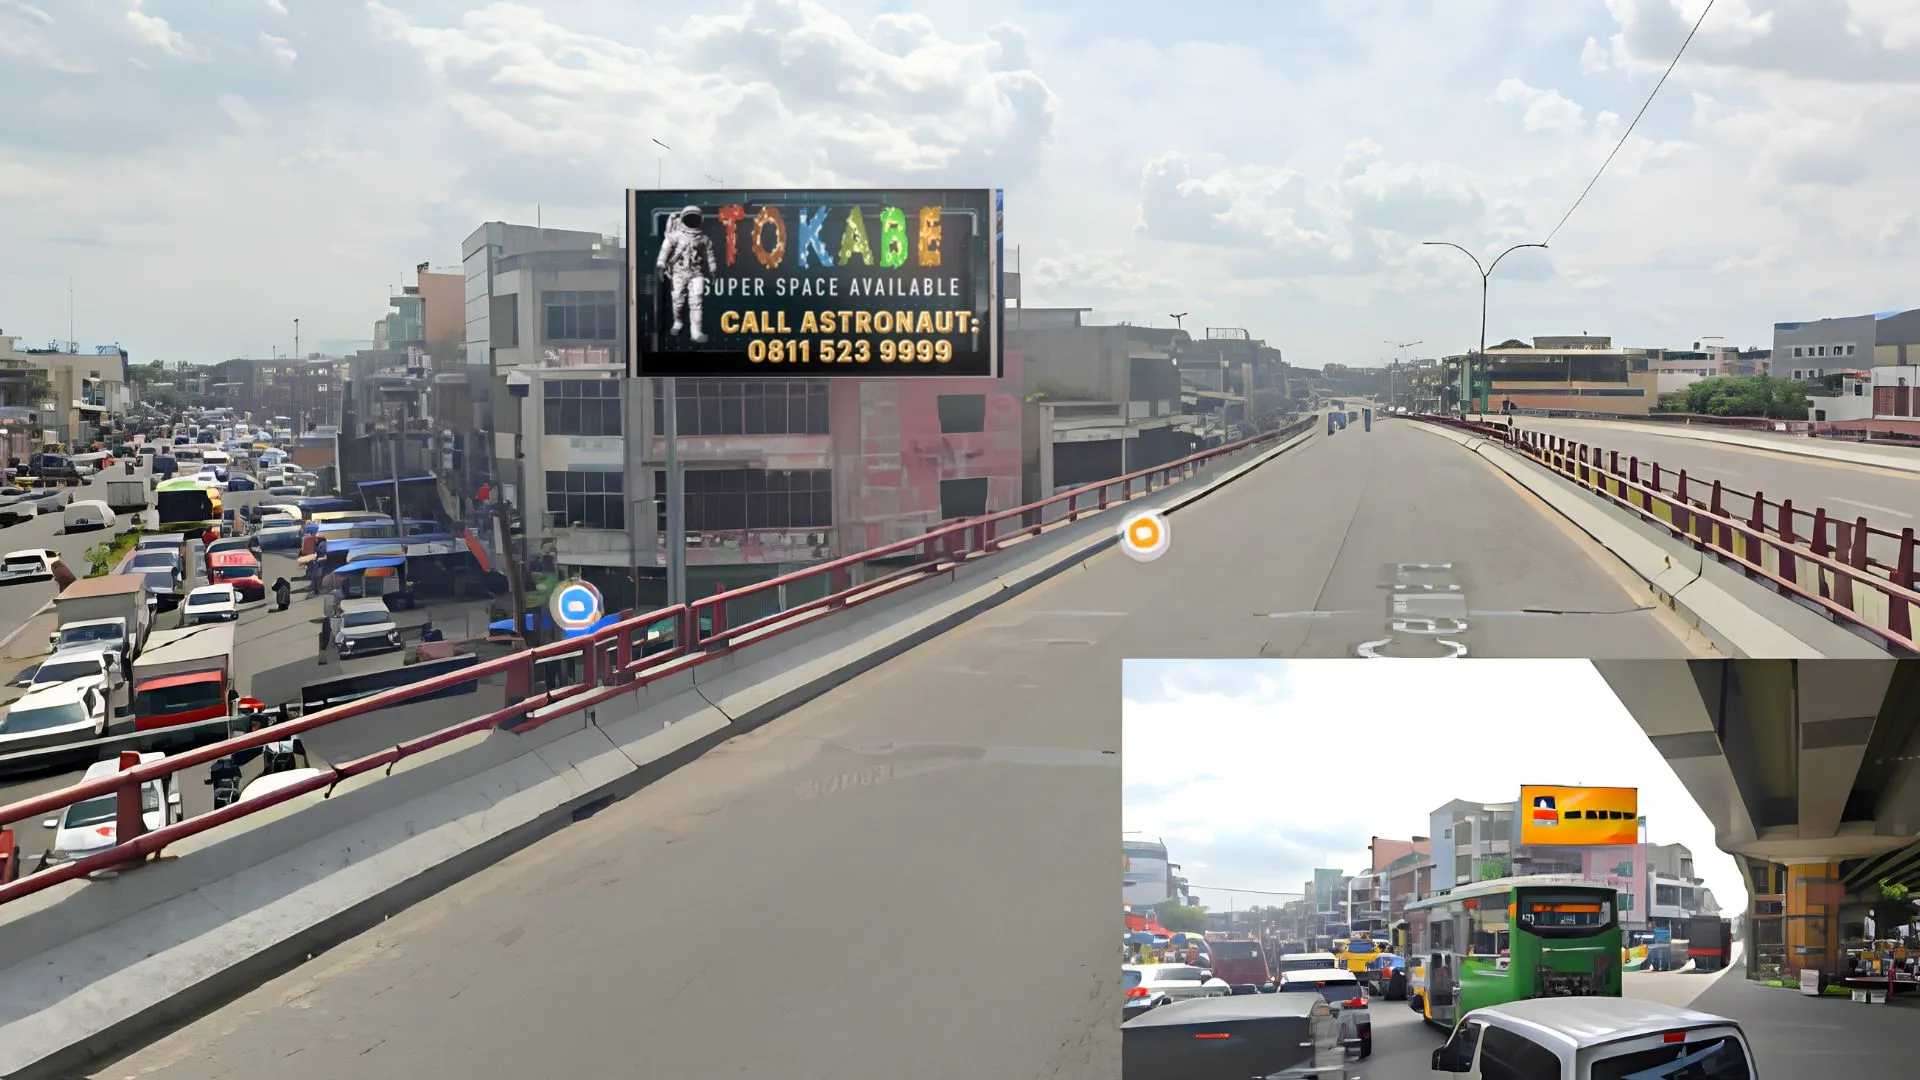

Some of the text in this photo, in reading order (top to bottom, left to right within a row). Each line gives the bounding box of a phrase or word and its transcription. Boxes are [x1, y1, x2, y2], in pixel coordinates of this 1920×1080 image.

[718, 204, 943, 269] TOKABE
[703, 278, 960, 297] SUPER SPACE AVAILABLE
[721, 310, 980, 335] CALL ASTRONAUT:
[748, 339, 953, 364] 0811 523 9999
